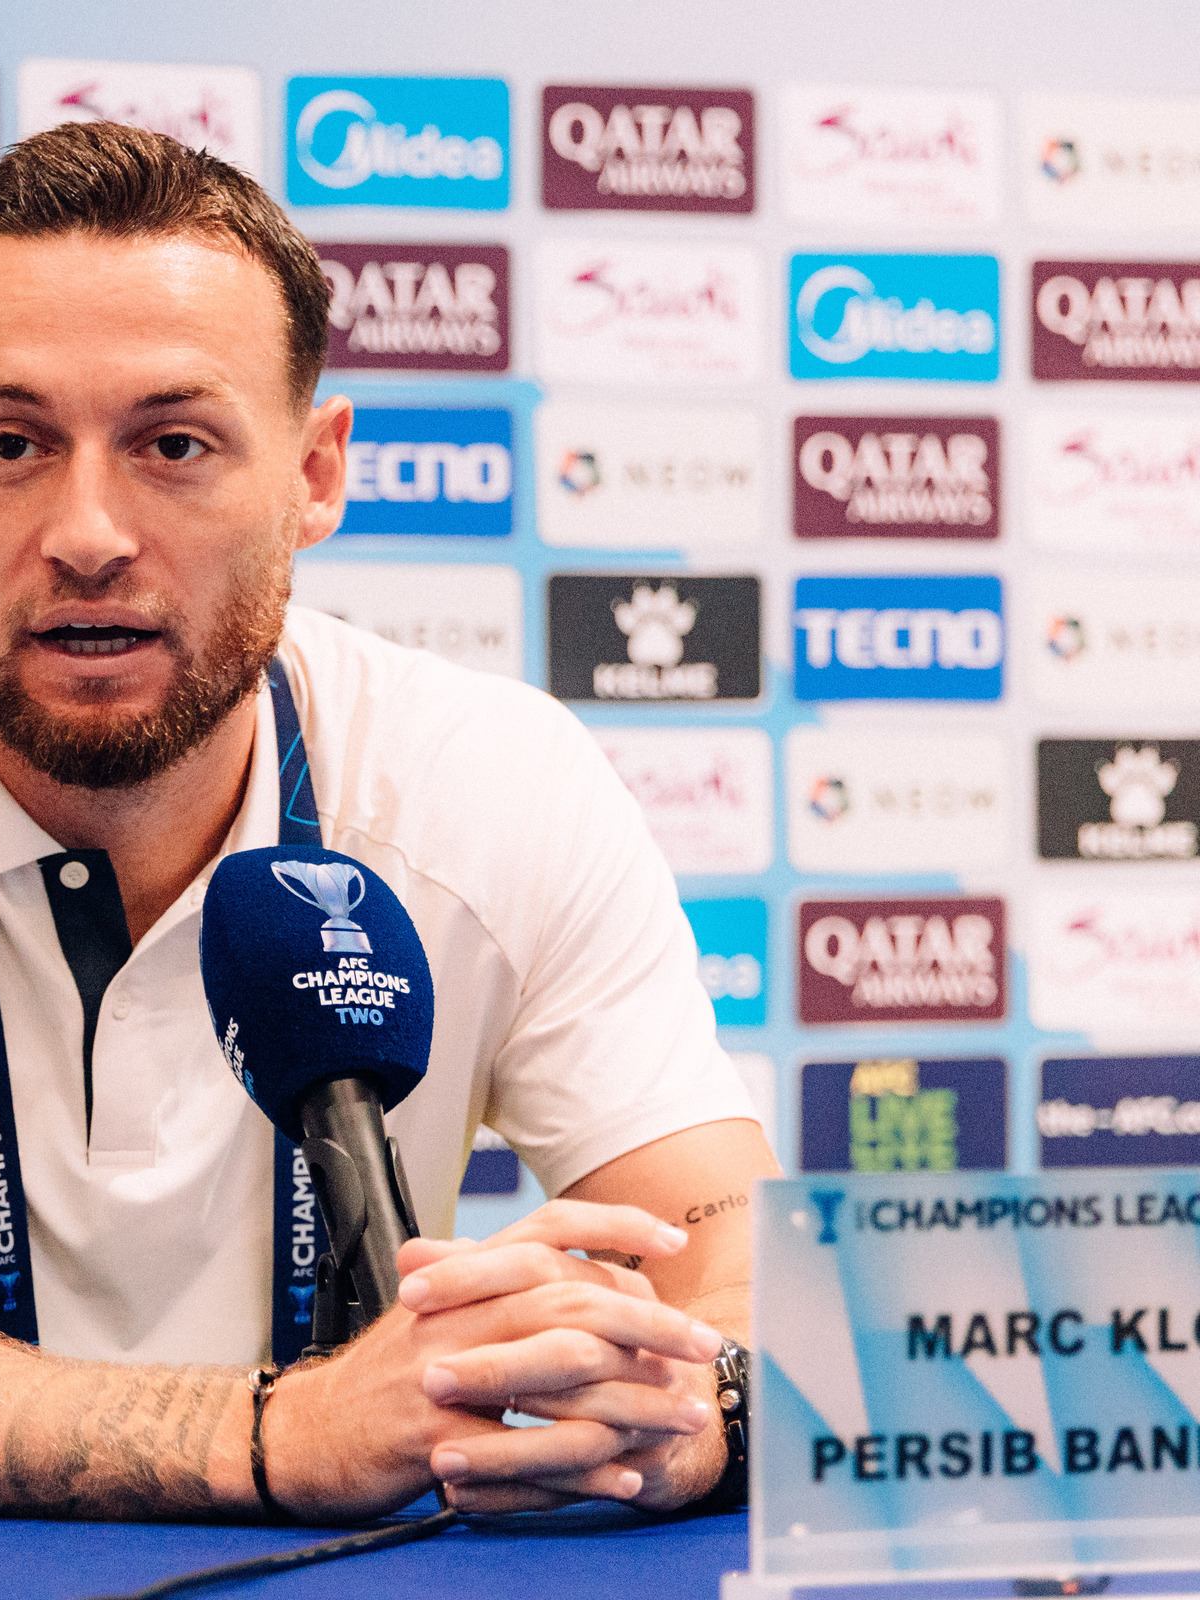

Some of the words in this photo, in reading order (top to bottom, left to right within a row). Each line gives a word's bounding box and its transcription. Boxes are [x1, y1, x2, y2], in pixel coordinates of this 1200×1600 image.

[312, 106, 503, 184] Midea
[548, 102, 744, 171] QATAR
[346, 441, 512, 503] ECNO
[799, 431, 989, 500] QATAR
[795, 608, 1000, 670] TECNO
[338, 957, 369, 970] AFC
[804, 915, 995, 985] QATAR
[292, 969, 411, 994] CHAMPIONS
[318, 987, 396, 1009] LEAGUE
[335, 1007, 384, 1026] TWO
[870, 1195, 1101, 1231] CHAMPIONS
[906, 1308, 1086, 1360] MARC
[811, 1428, 1040, 1482] PERSIB
[1064, 1424, 1200, 1473] BAN
